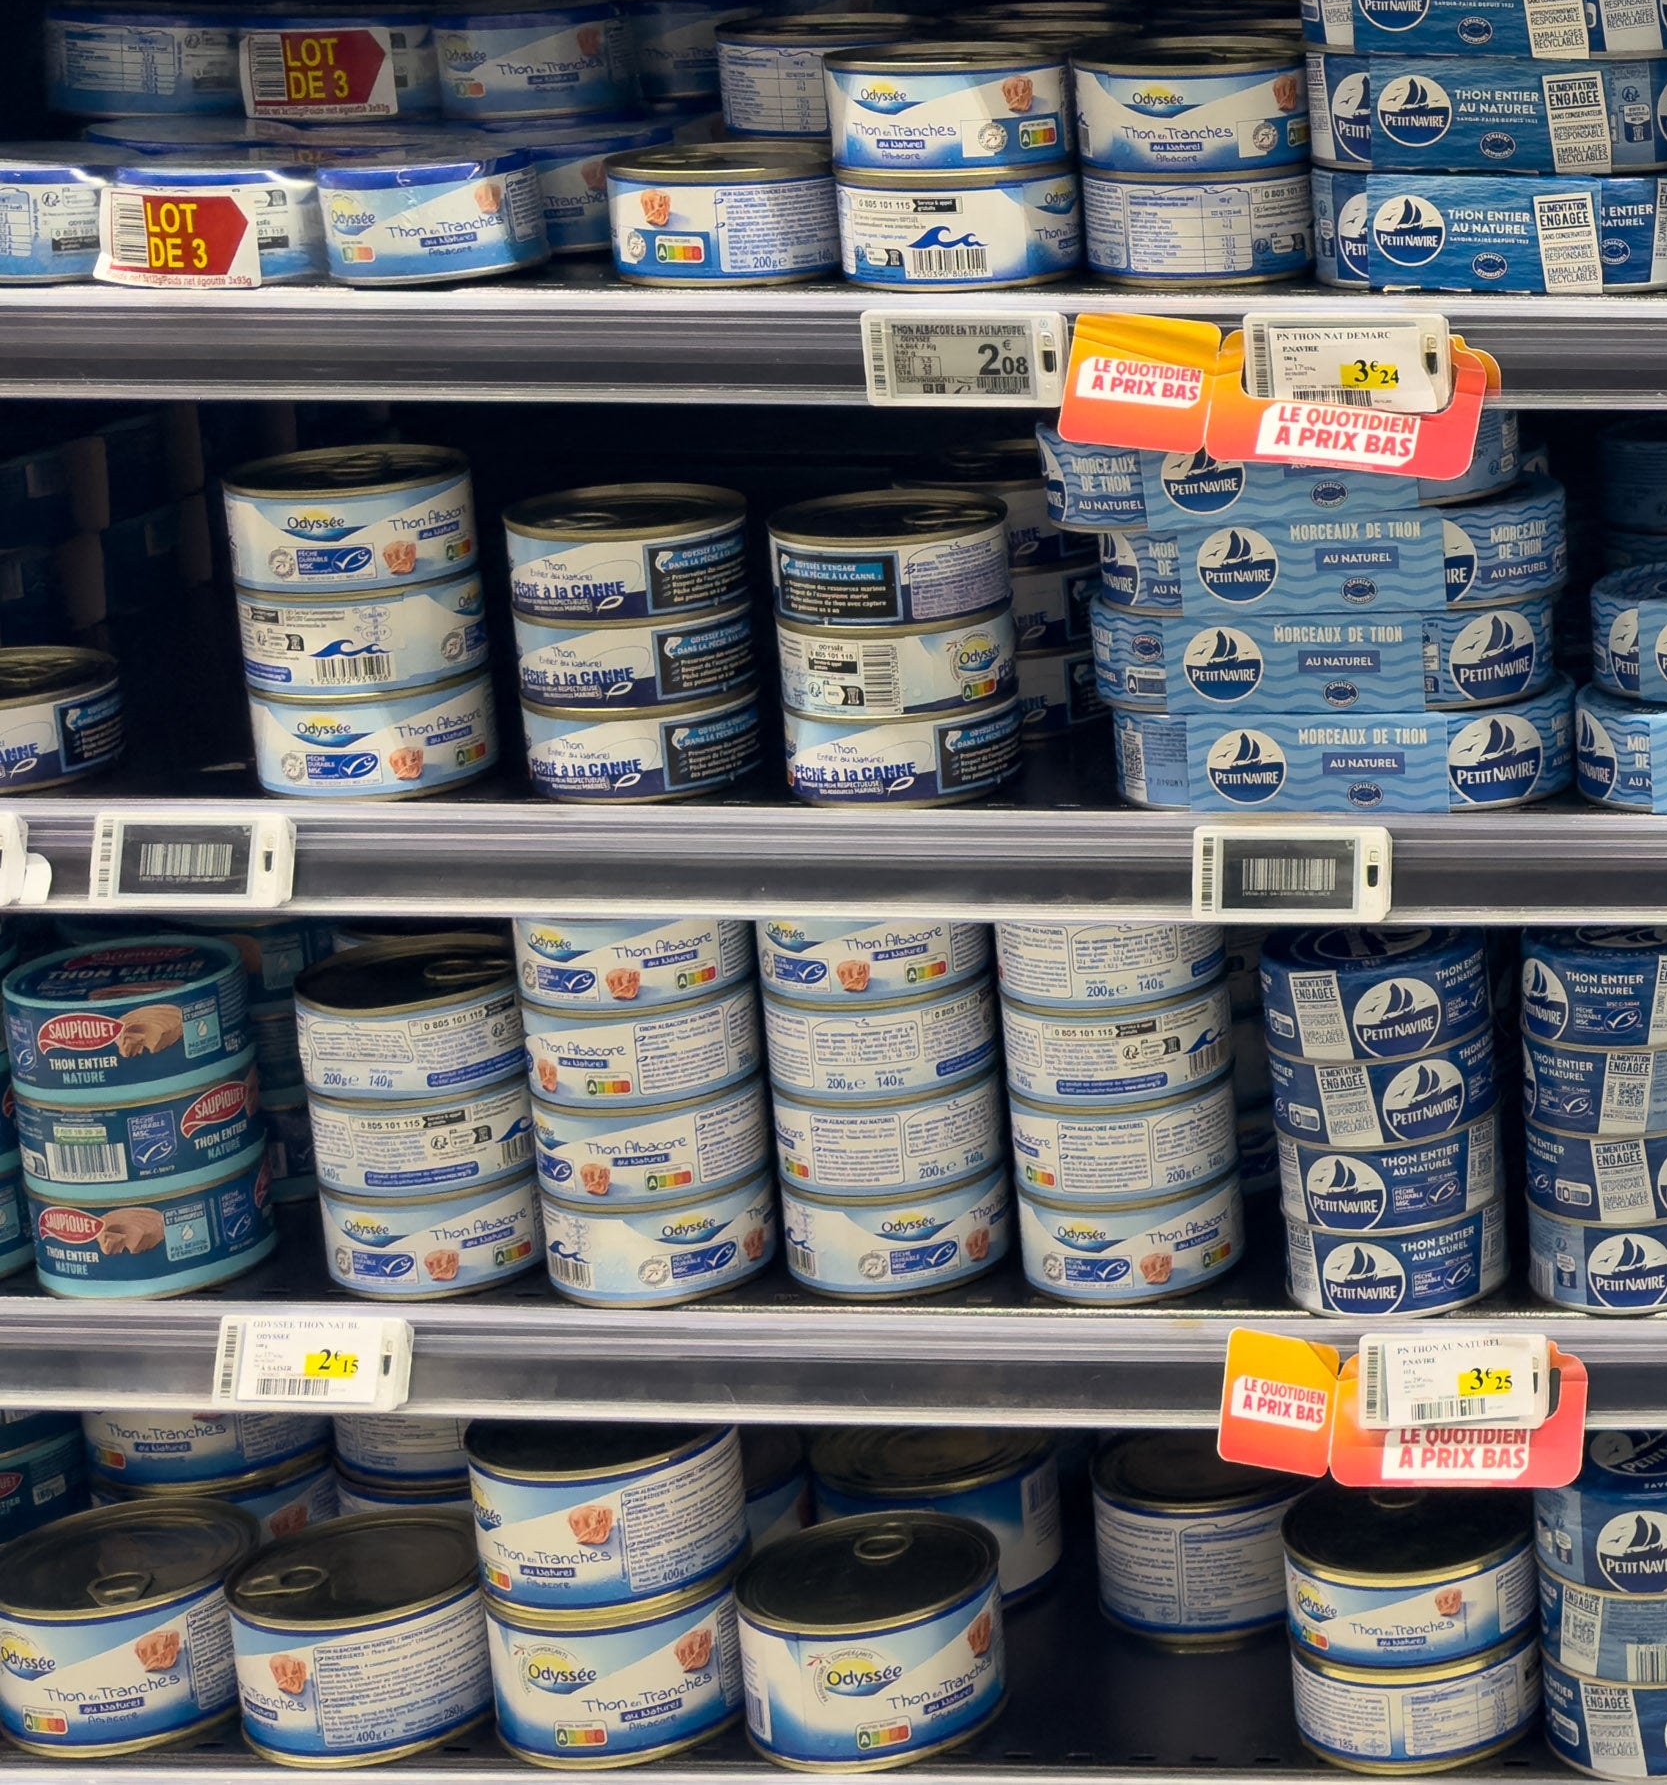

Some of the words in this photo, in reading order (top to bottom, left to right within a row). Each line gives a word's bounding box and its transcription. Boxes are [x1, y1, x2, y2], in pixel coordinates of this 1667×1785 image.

[861, 88, 906, 103] Odyssée
[853, 122, 880, 136] Thon
[146, 203, 197, 233] LOT
[151, 238, 184, 267] DE
[191, 239, 207, 269] 3
[1299, 728, 1365, 744] MORCEAUX
[1372, 728, 1388, 744] DE
[1395, 728, 1427, 744] THON
[843, 767, 857, 781] la
[861, 763, 916, 781] CANNE
[49, 1020, 115, 1038] SAUPIQUET
